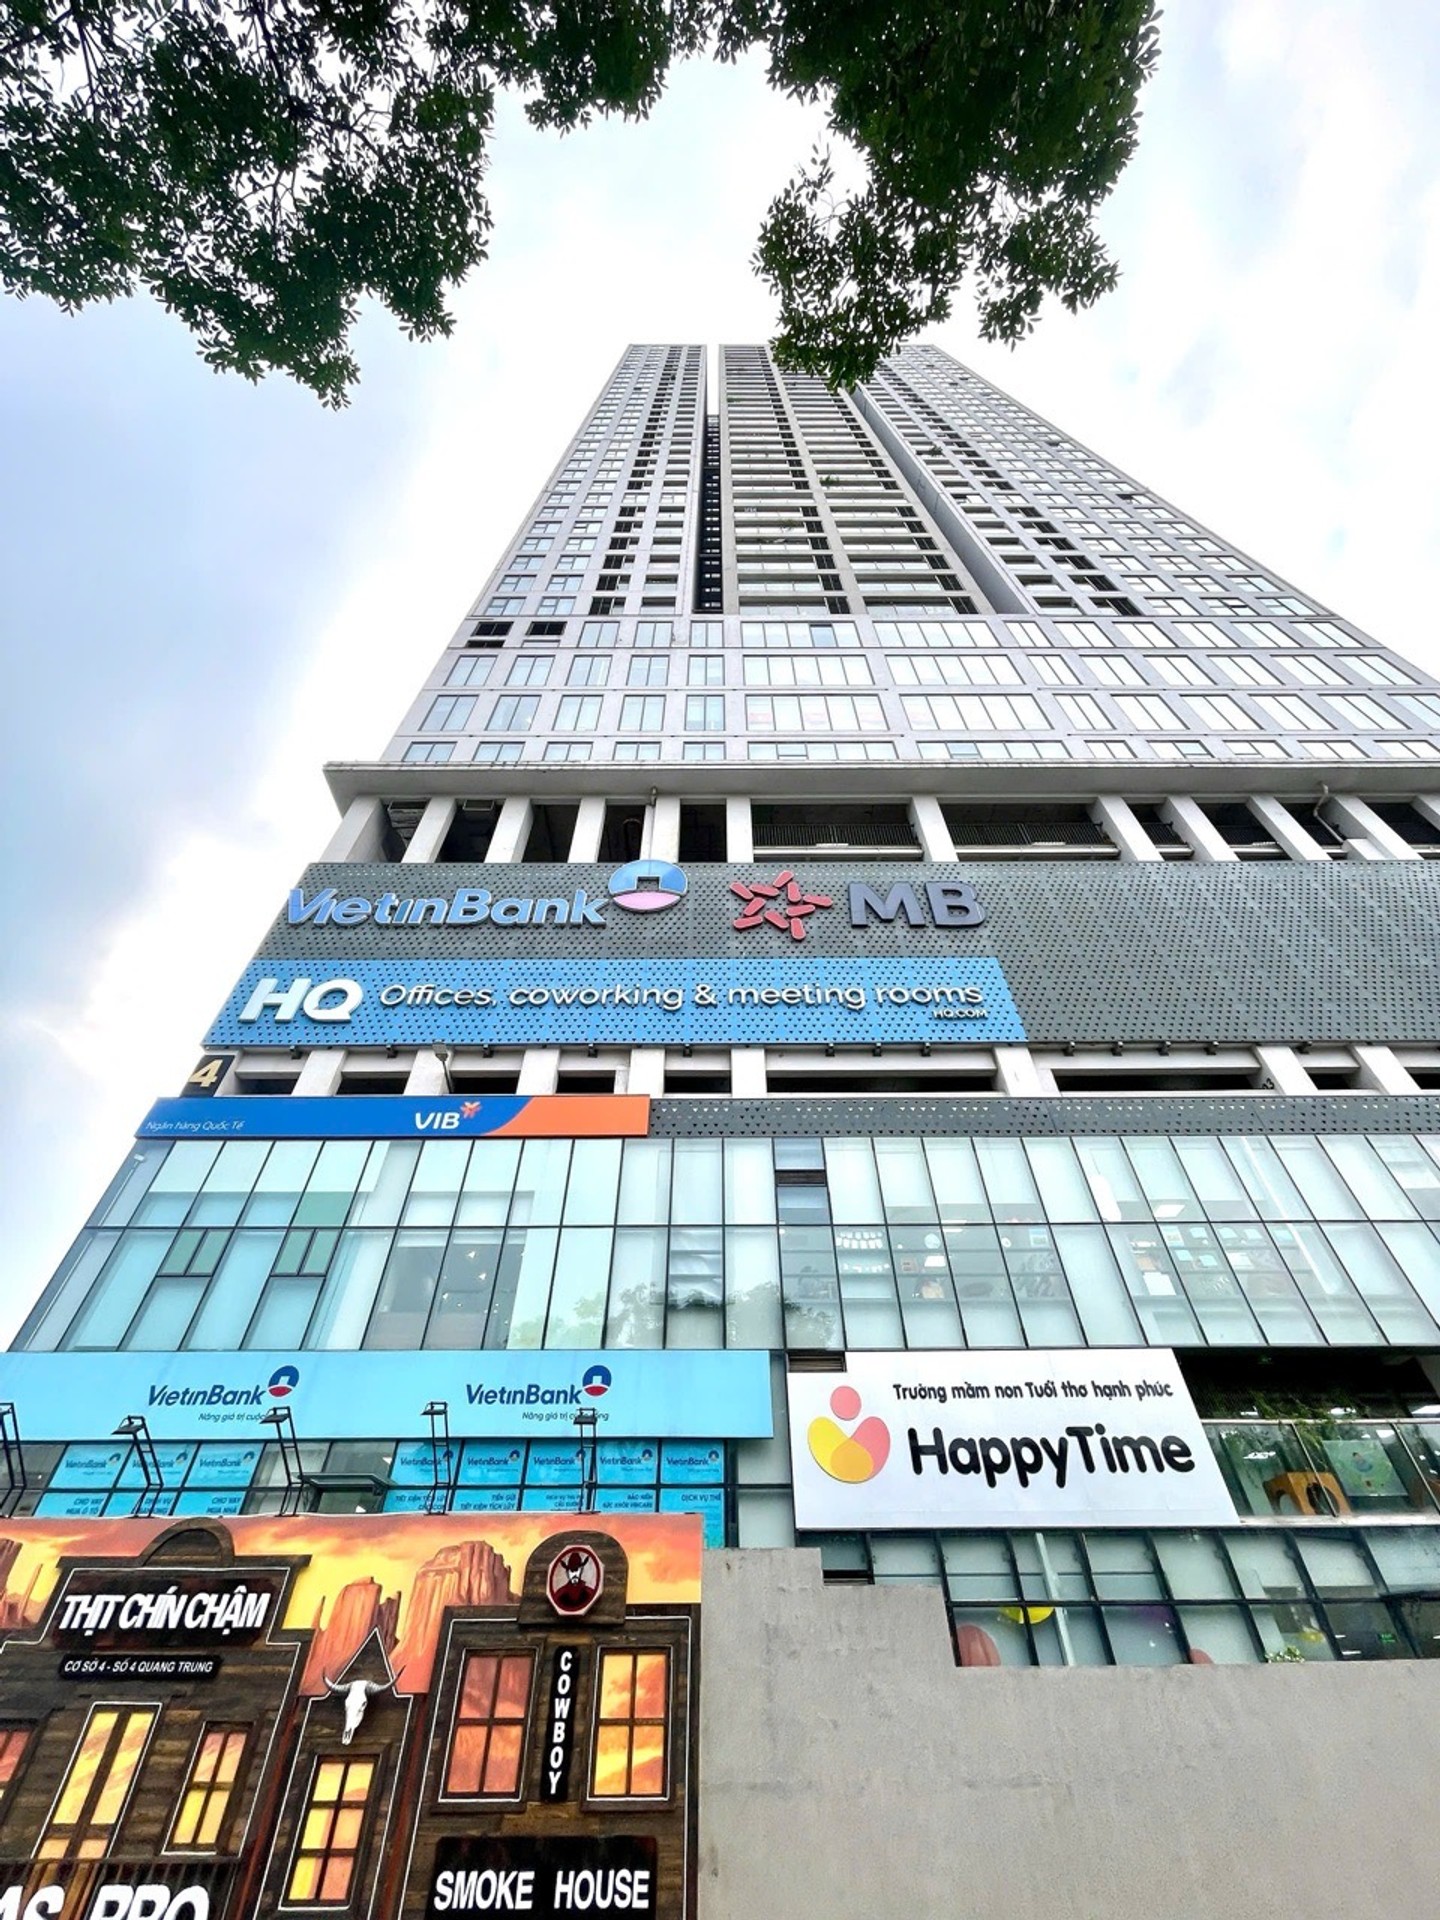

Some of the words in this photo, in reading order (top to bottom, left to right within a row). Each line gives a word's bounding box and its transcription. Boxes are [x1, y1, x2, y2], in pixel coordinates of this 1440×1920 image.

[285, 887, 607, 927] VietinBank
[849, 880, 986, 928] MB
[238, 977, 363, 1023] HQ
[380, 984, 497, 1008] Offices,
[508, 984, 684, 1012] coworking
[694, 983, 717, 1006] &
[728, 983, 867, 1010] meeting
[876, 985, 984, 1004] rooms
[933, 1007, 988, 1020] HQ.COM
[188, 1059, 223, 1088] 4
[415, 1111, 461, 1130] VIB
[148, 1384, 266, 1406] VietinBank
[466, 1384, 583, 1405] VietinBank
[893, 1384, 947, 1403] Trường
[952, 1382, 990, 1399] mầm
[994, 1385, 1023, 1399] non
[1061, 1380, 1088, 1398] thơ
[1091, 1380, 1131, 1400] hạnh
[1136, 1380, 1173, 1401] phúc
[907, 1423, 1195, 1488] HappyTime
[58, 1594, 125, 1636] THỊT
[118, 1586, 189, 1630] CHÍN
[184, 1585, 272, 1635] CHẬM
[129, 1661, 137, 1672] 4
[137, 1661, 176, 1672] QUANG
[177, 1661, 213, 1672] TRUNG
[549, 1651, 572, 1794] COWBOY
[433, 1869, 535, 1910] SMOKE
[553, 1869, 650, 1909] HOUSE
